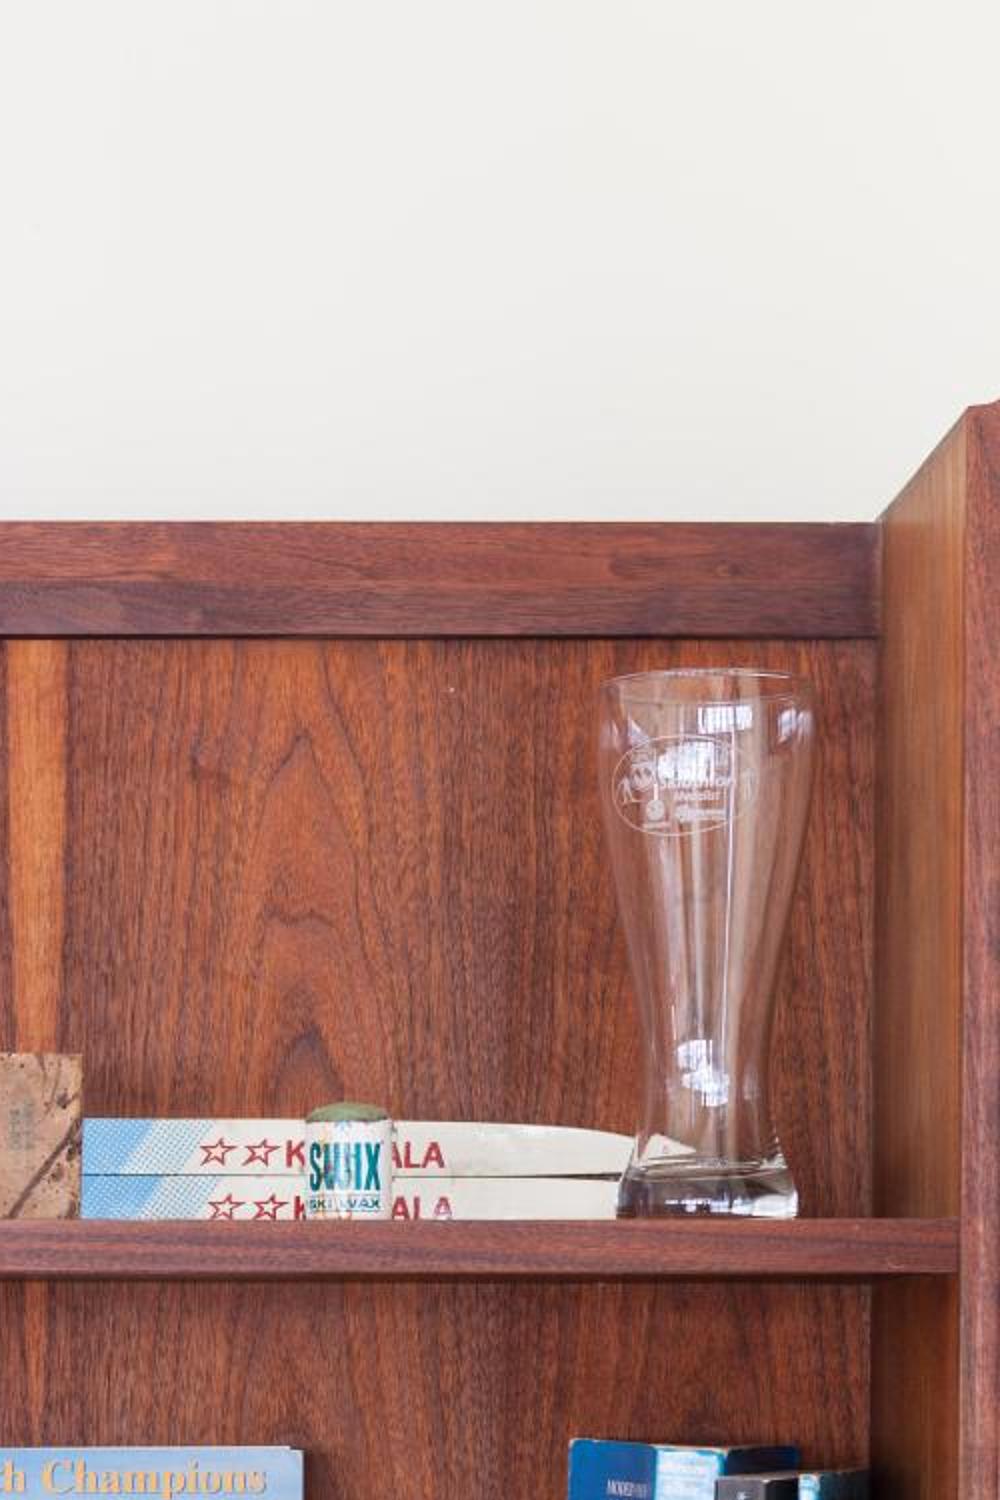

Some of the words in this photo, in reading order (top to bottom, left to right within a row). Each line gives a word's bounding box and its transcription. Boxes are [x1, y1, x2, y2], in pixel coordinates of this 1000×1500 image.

[309, 1142, 382, 1191] SWIX
[311, 1198, 333, 1210] SKI
[349, 1198, 381, 1210] WAX
[40, 1457, 268, 1500] Champions
